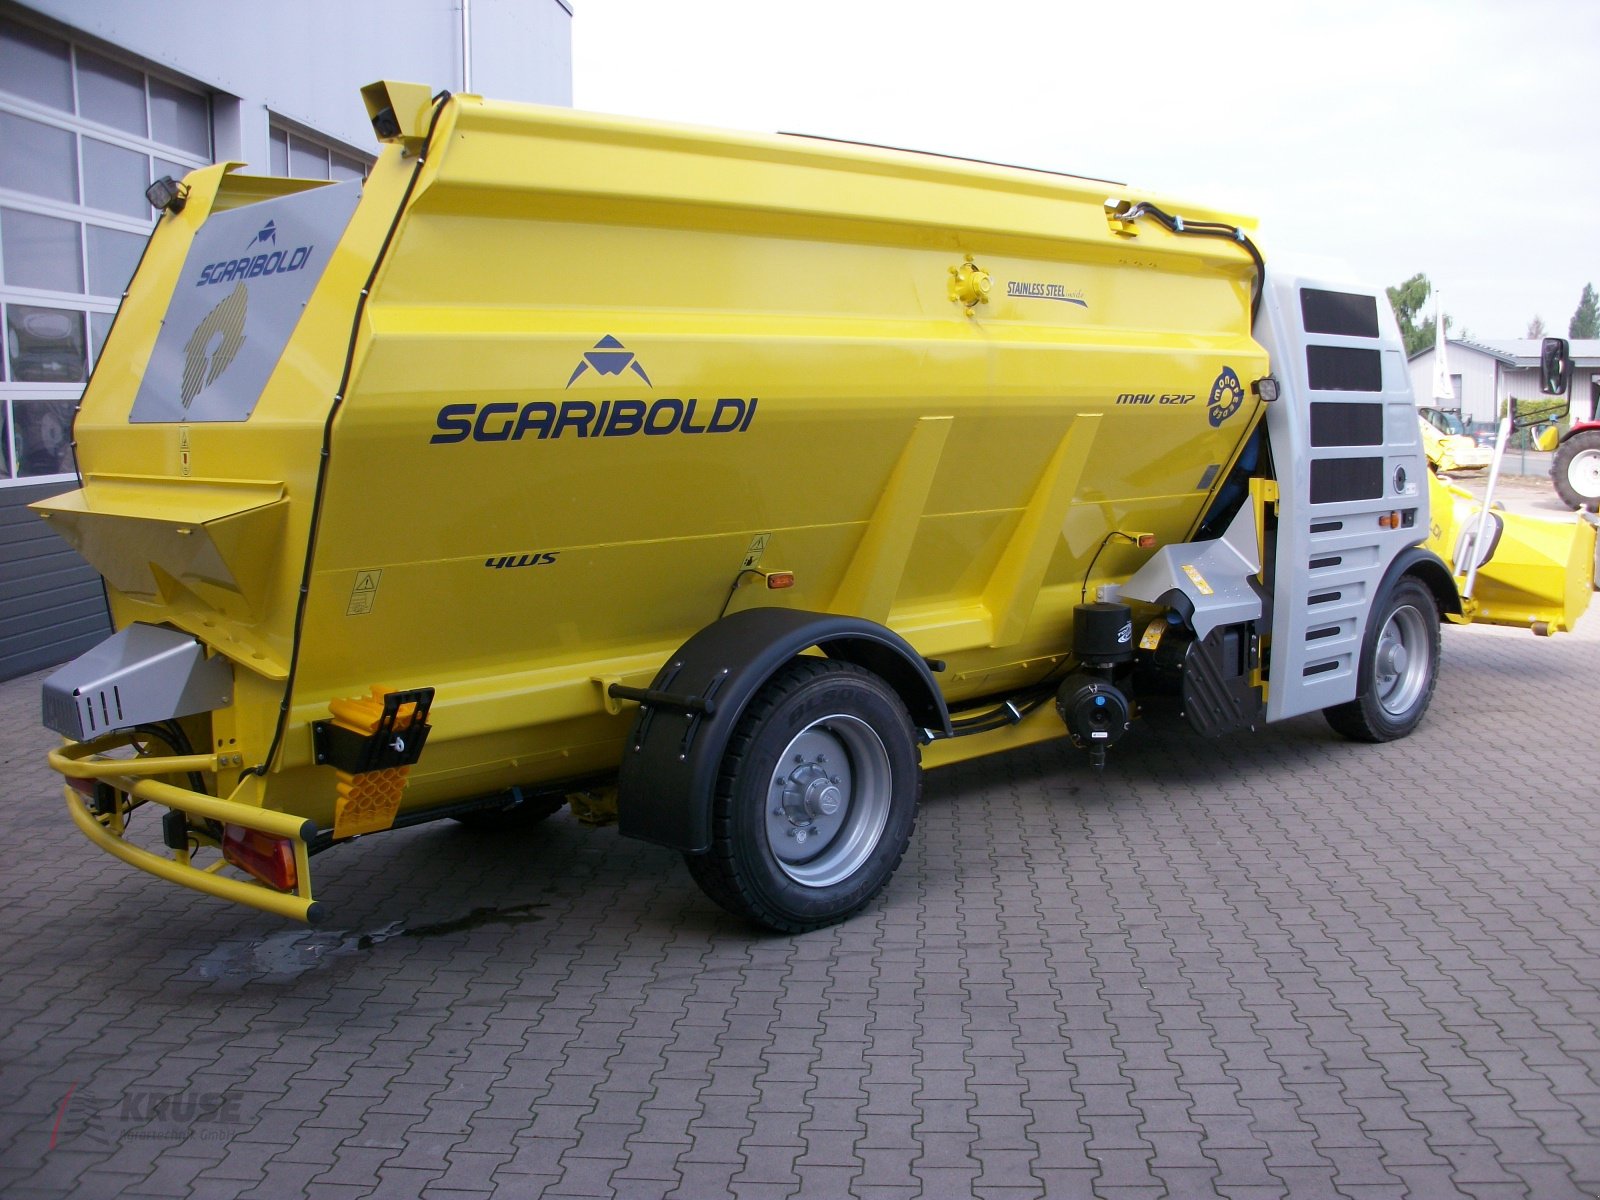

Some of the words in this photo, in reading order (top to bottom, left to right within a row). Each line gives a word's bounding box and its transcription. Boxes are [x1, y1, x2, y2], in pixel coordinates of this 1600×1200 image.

[196, 245, 314, 287] SGARIBOLDI
[1007, 281, 1045, 296] STAINLESS
[1046, 284, 1065, 297] STEEL
[1116, 394, 1155, 405] MAV
[1159, 394, 1195, 405] 6217
[429, 397, 758, 444] SGARIBOLDI
[485, 551, 560, 569] 4WS
